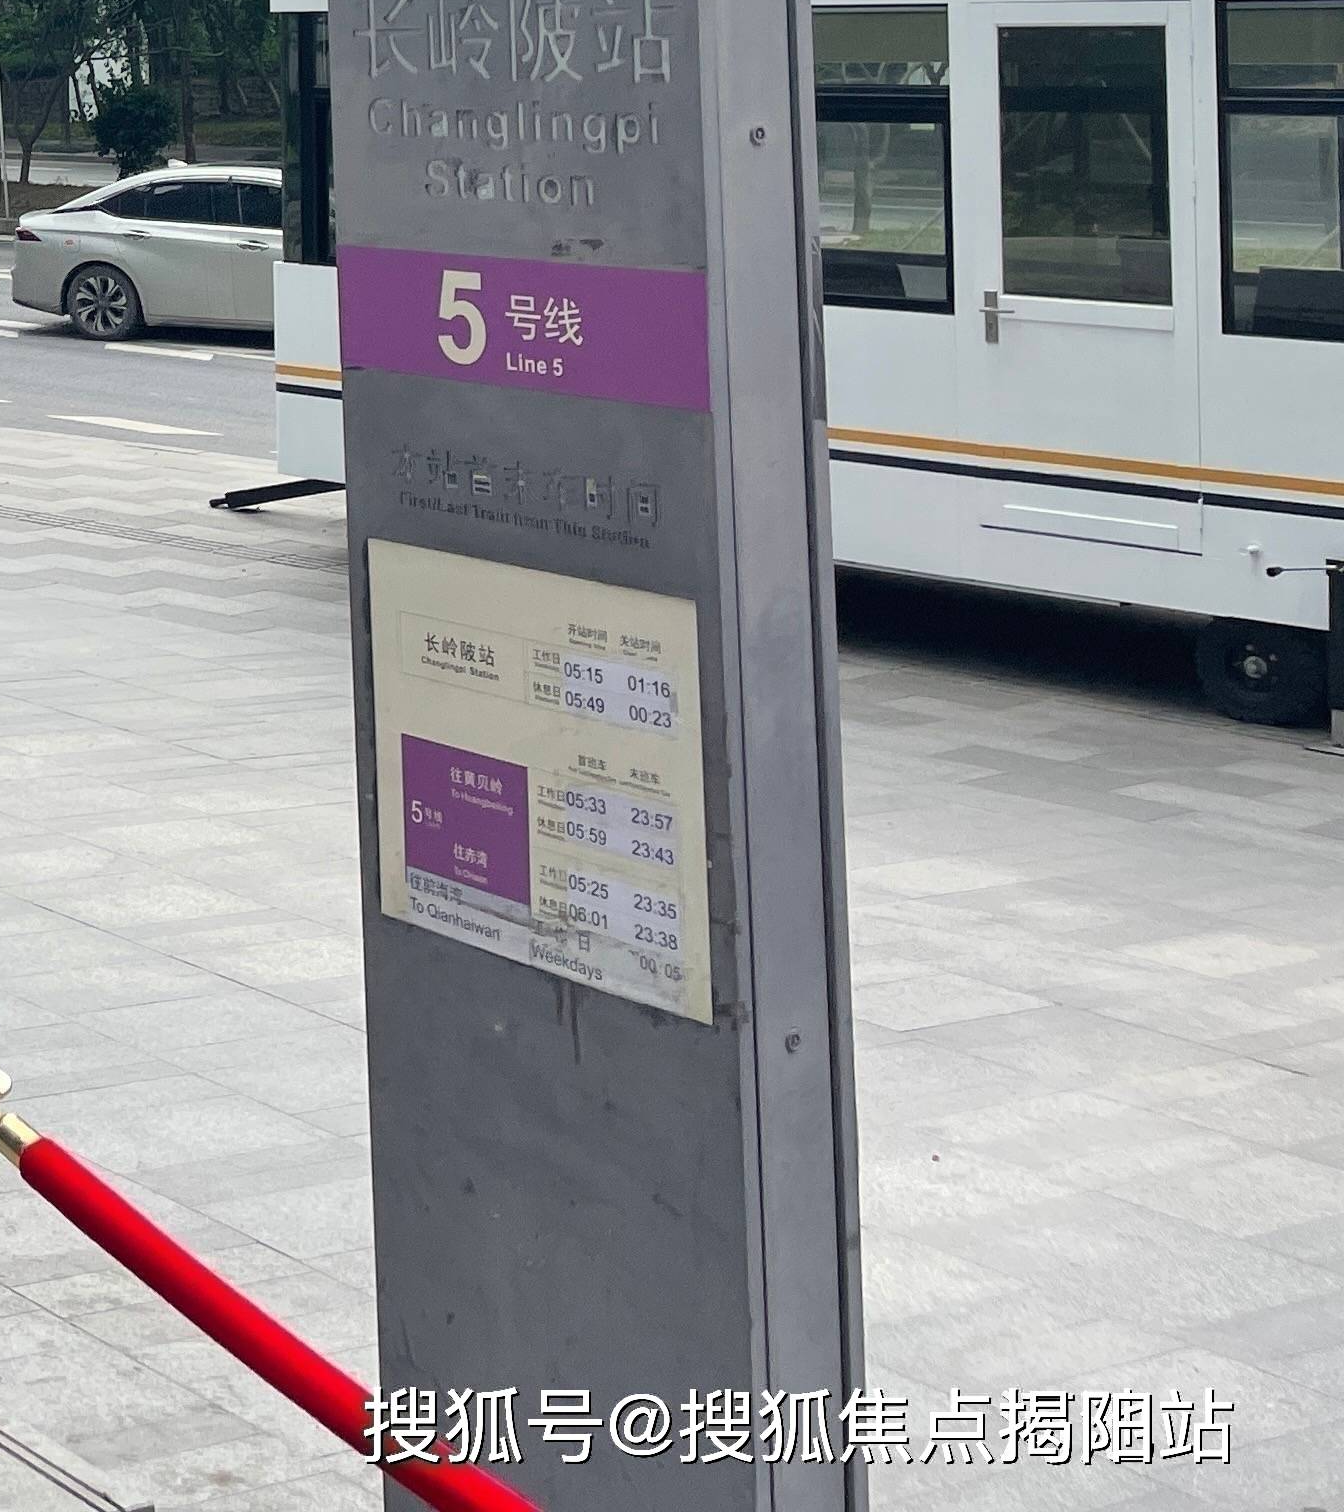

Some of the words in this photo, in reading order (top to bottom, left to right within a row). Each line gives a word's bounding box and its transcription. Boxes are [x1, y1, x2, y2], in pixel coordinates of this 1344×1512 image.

[368, 97, 659, 155] Changlingpi
[425, 159, 595, 207] Station
[506, 352, 547, 375] Line
[552, 358, 564, 377] 5
[424, 632, 495, 667] 长岭陂站
[533, 649, 561, 665] 工作日
[564, 662, 603, 684] 05:15
[627, 675, 670, 698] 01:16
[565, 691, 605, 713] 05:49
[629, 705, 671, 728] 00:23
[566, 791, 606, 815] 05:33
[631, 808, 673, 831] 23:57
[567, 821, 607, 845] 05:59
[632, 840, 674, 865] 23:43
[568, 874, 608, 899] 05:25
[634, 894, 676, 919] 23:35
[410, 897, 424, 913] To
[427, 903, 500, 941] Qianhaiwan
[569, 904, 608, 929] 06:01
[634, 924, 678, 950] 23:38
[530, 940, 603, 981] Weekdays
